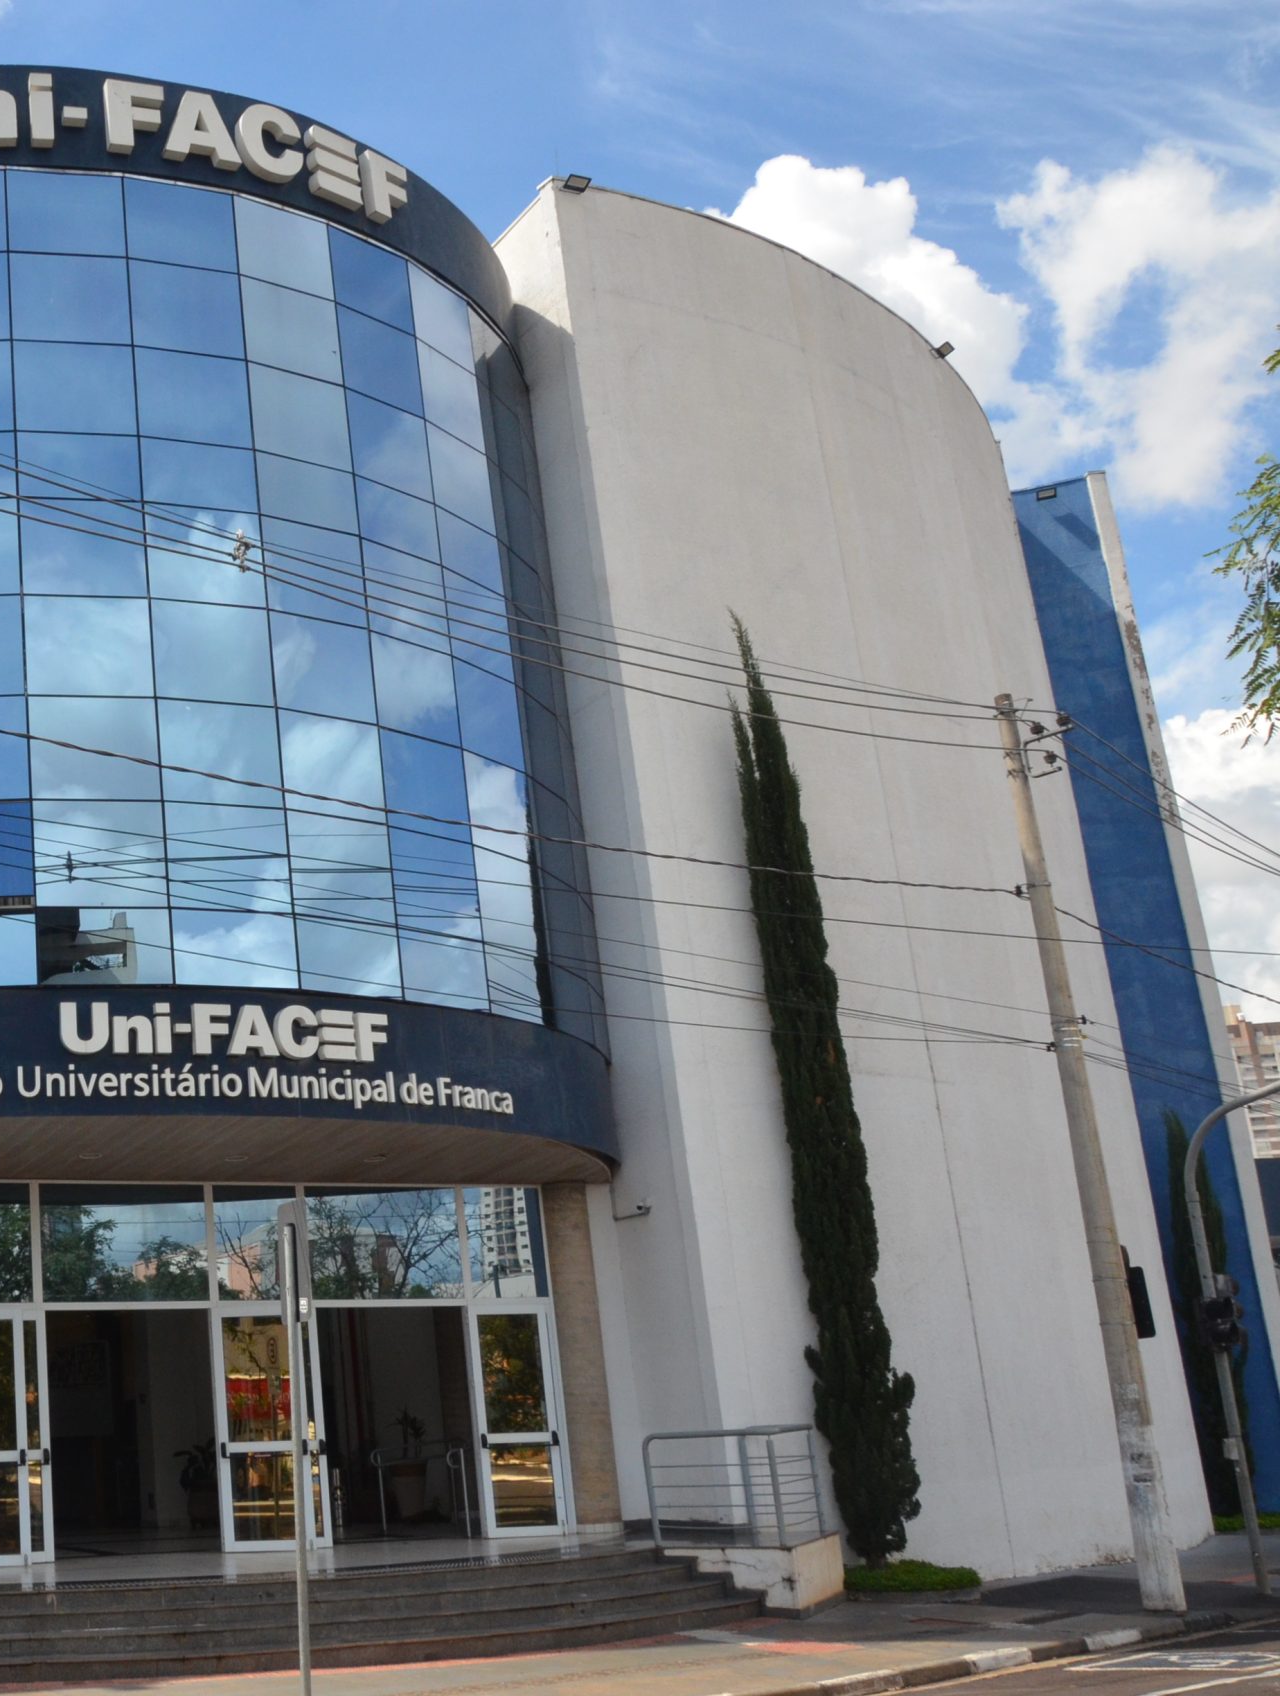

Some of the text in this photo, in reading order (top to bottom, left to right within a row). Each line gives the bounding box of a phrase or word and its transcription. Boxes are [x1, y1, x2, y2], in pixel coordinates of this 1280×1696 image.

[59, 1001, 389, 1063] Uni-FACEF
[16, 1062, 244, 1099] Universitário
[247, 1065, 396, 1110] Municipal
[400, 1072, 434, 1106] de
[436, 1077, 514, 1115] Franca
